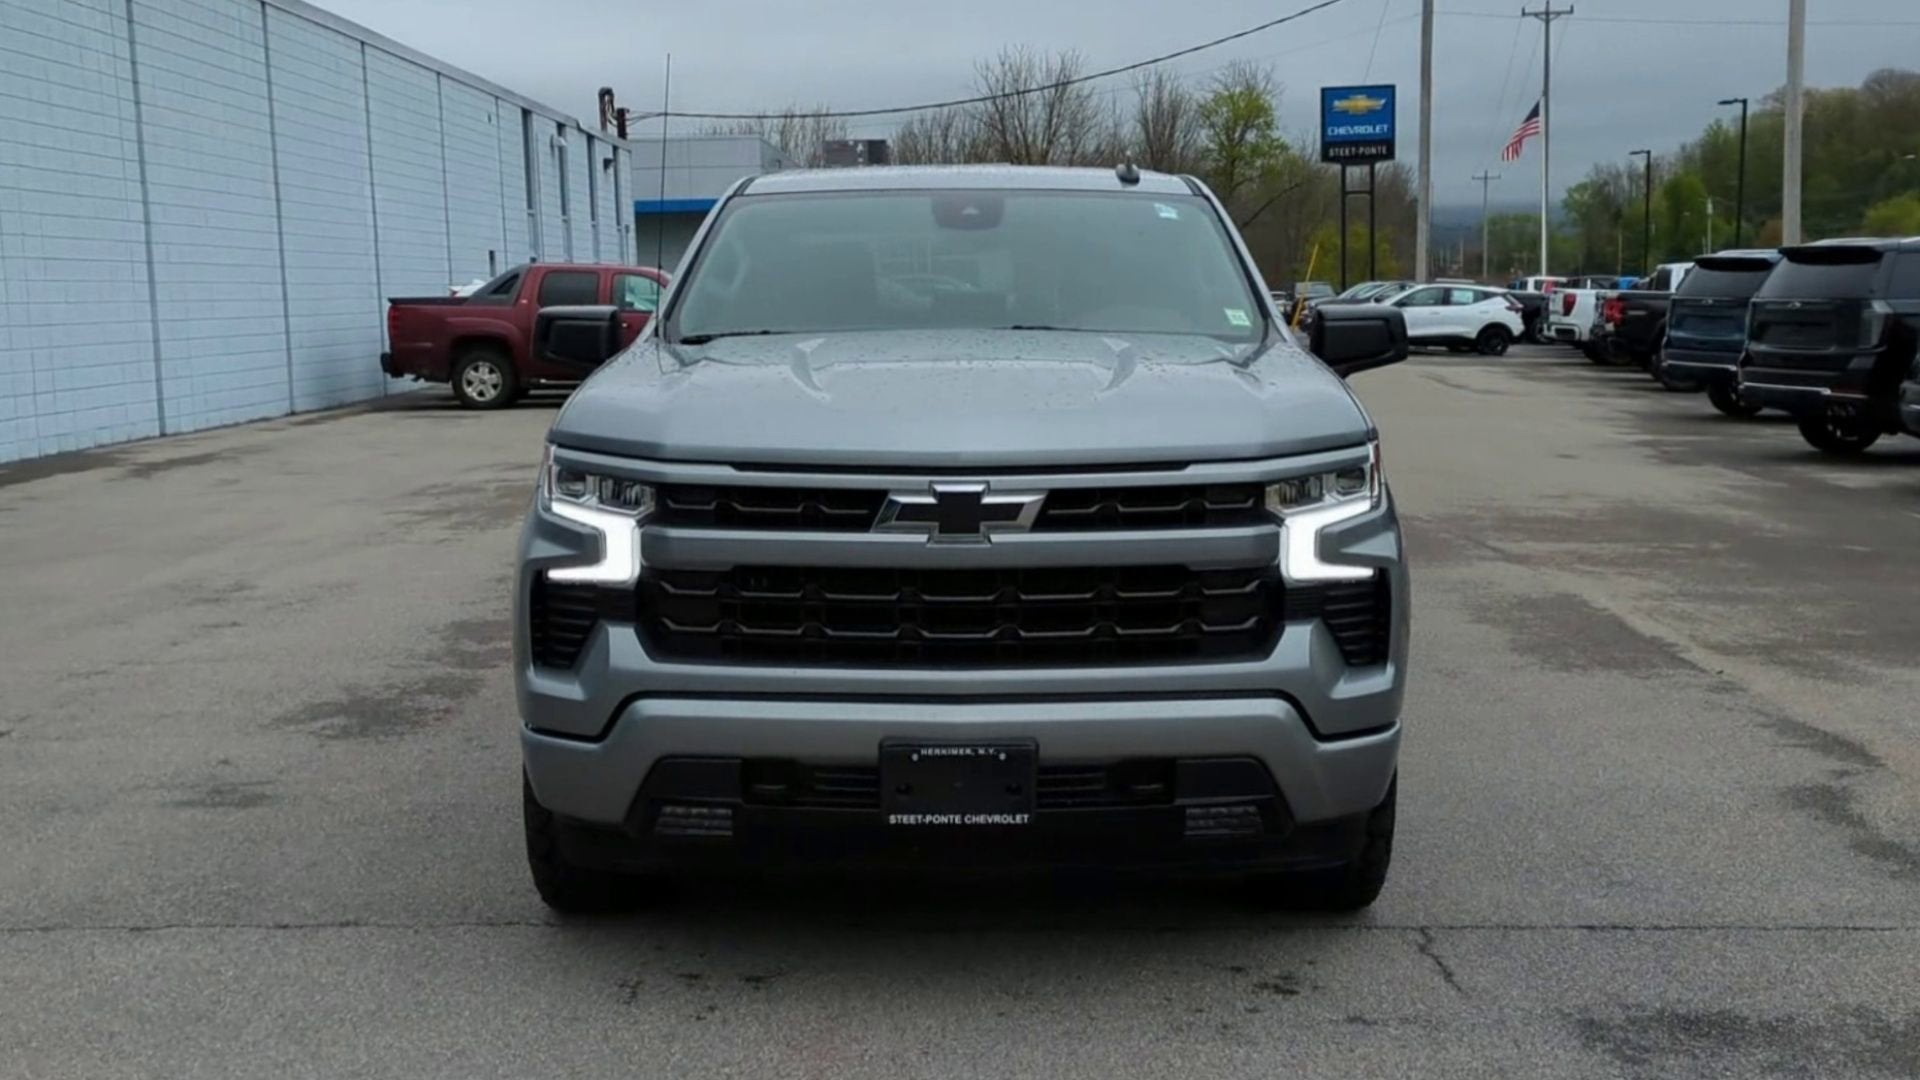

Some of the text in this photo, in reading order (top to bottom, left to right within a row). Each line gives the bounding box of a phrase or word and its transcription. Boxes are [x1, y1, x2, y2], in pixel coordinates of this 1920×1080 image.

[1327, 124, 1389, 136] CHEVROLET
[1328, 145, 1388, 157] STEET-PONTE
[889, 813, 1030, 825] STEET-PONTE CHEVROLET
